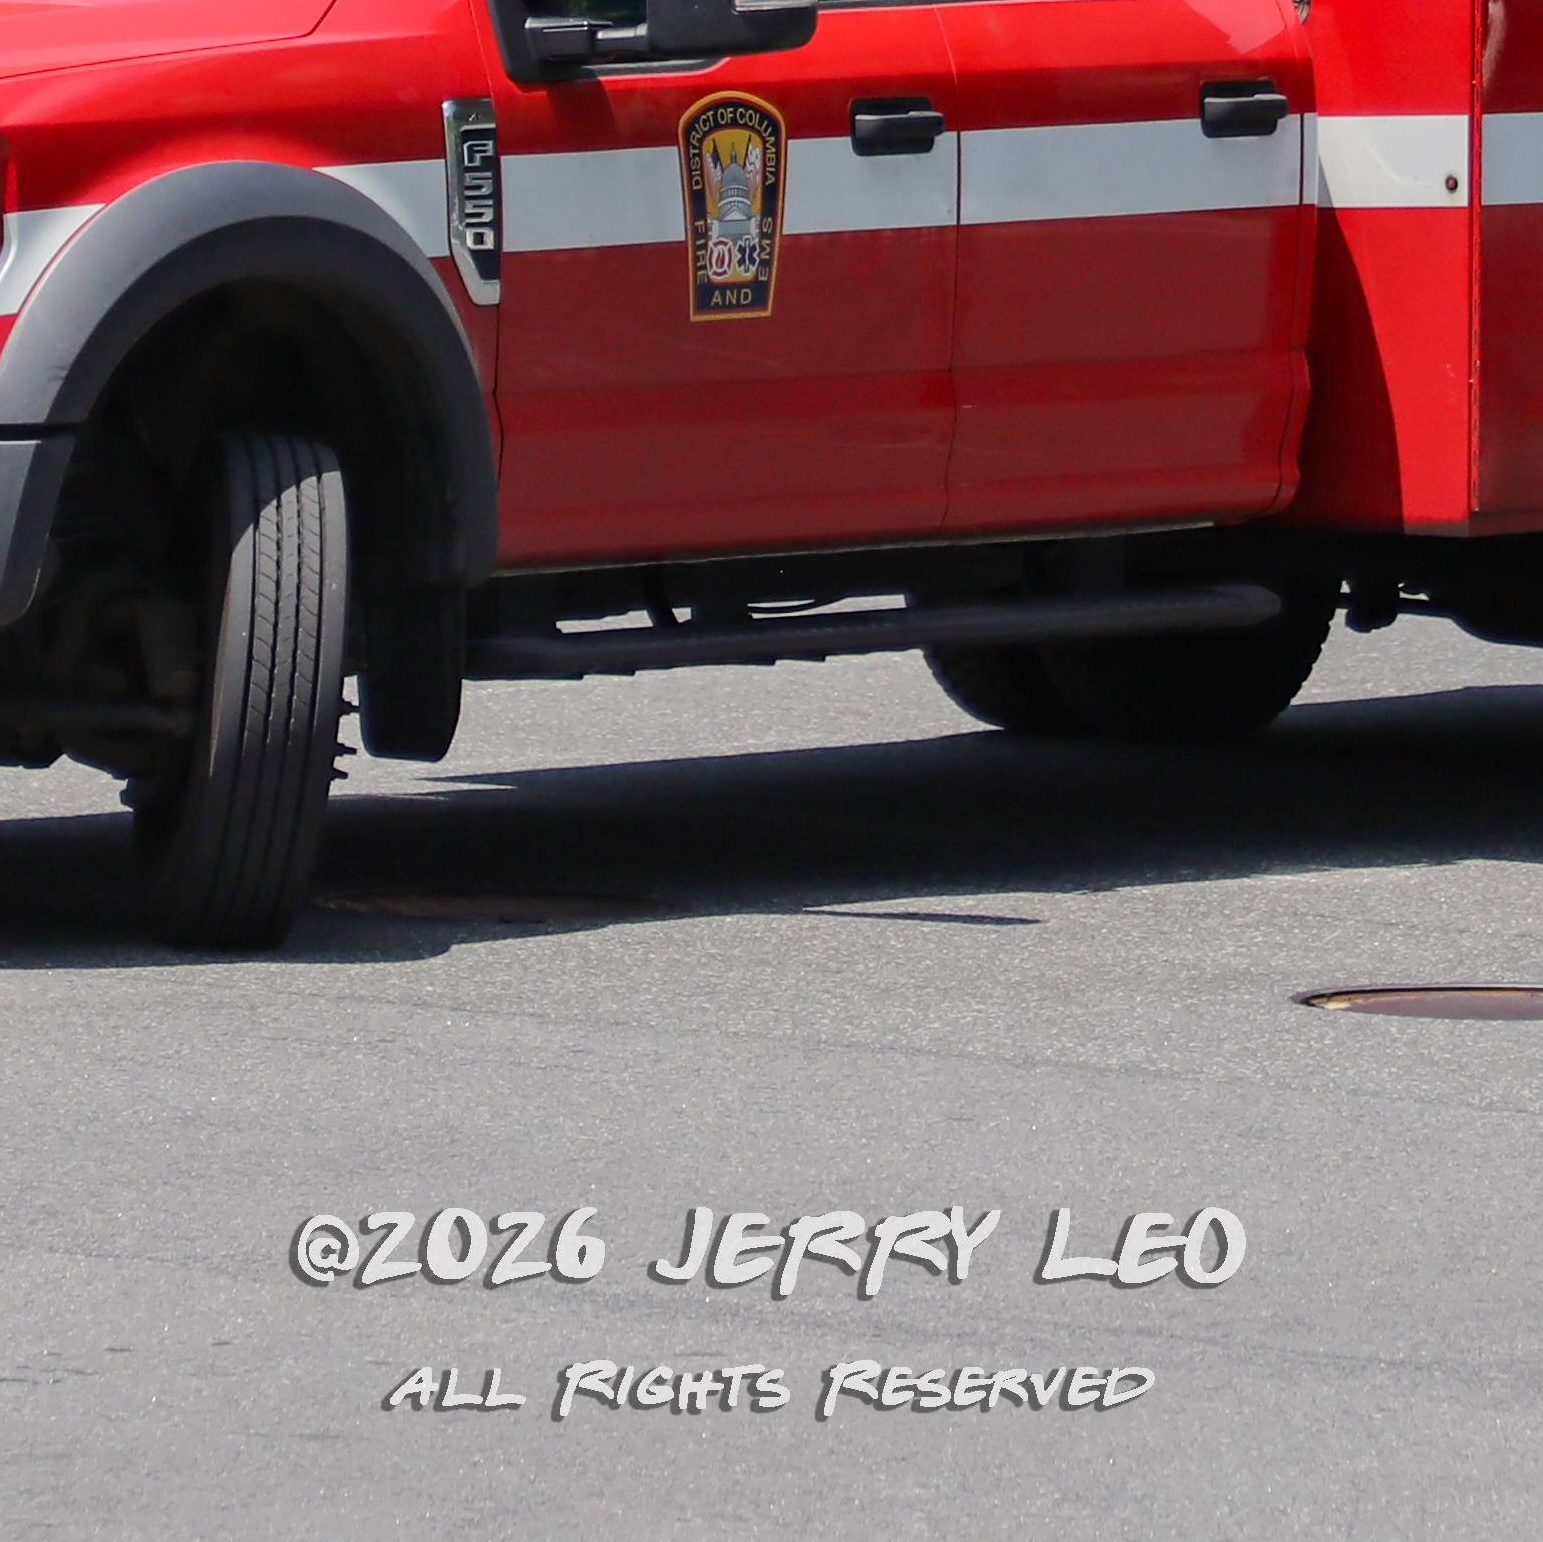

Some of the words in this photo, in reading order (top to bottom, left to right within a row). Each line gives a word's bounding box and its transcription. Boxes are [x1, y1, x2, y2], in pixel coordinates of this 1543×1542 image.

[689, 111, 715, 191] DISTRICT
[716, 107, 735, 126] OF
[735, 107, 777, 186] COLUMBIA
[463, 139, 495, 250] F550
[694, 218, 708, 283] FIRE
[757, 216, 774, 282] EMS
[710, 287, 753, 307] AND
